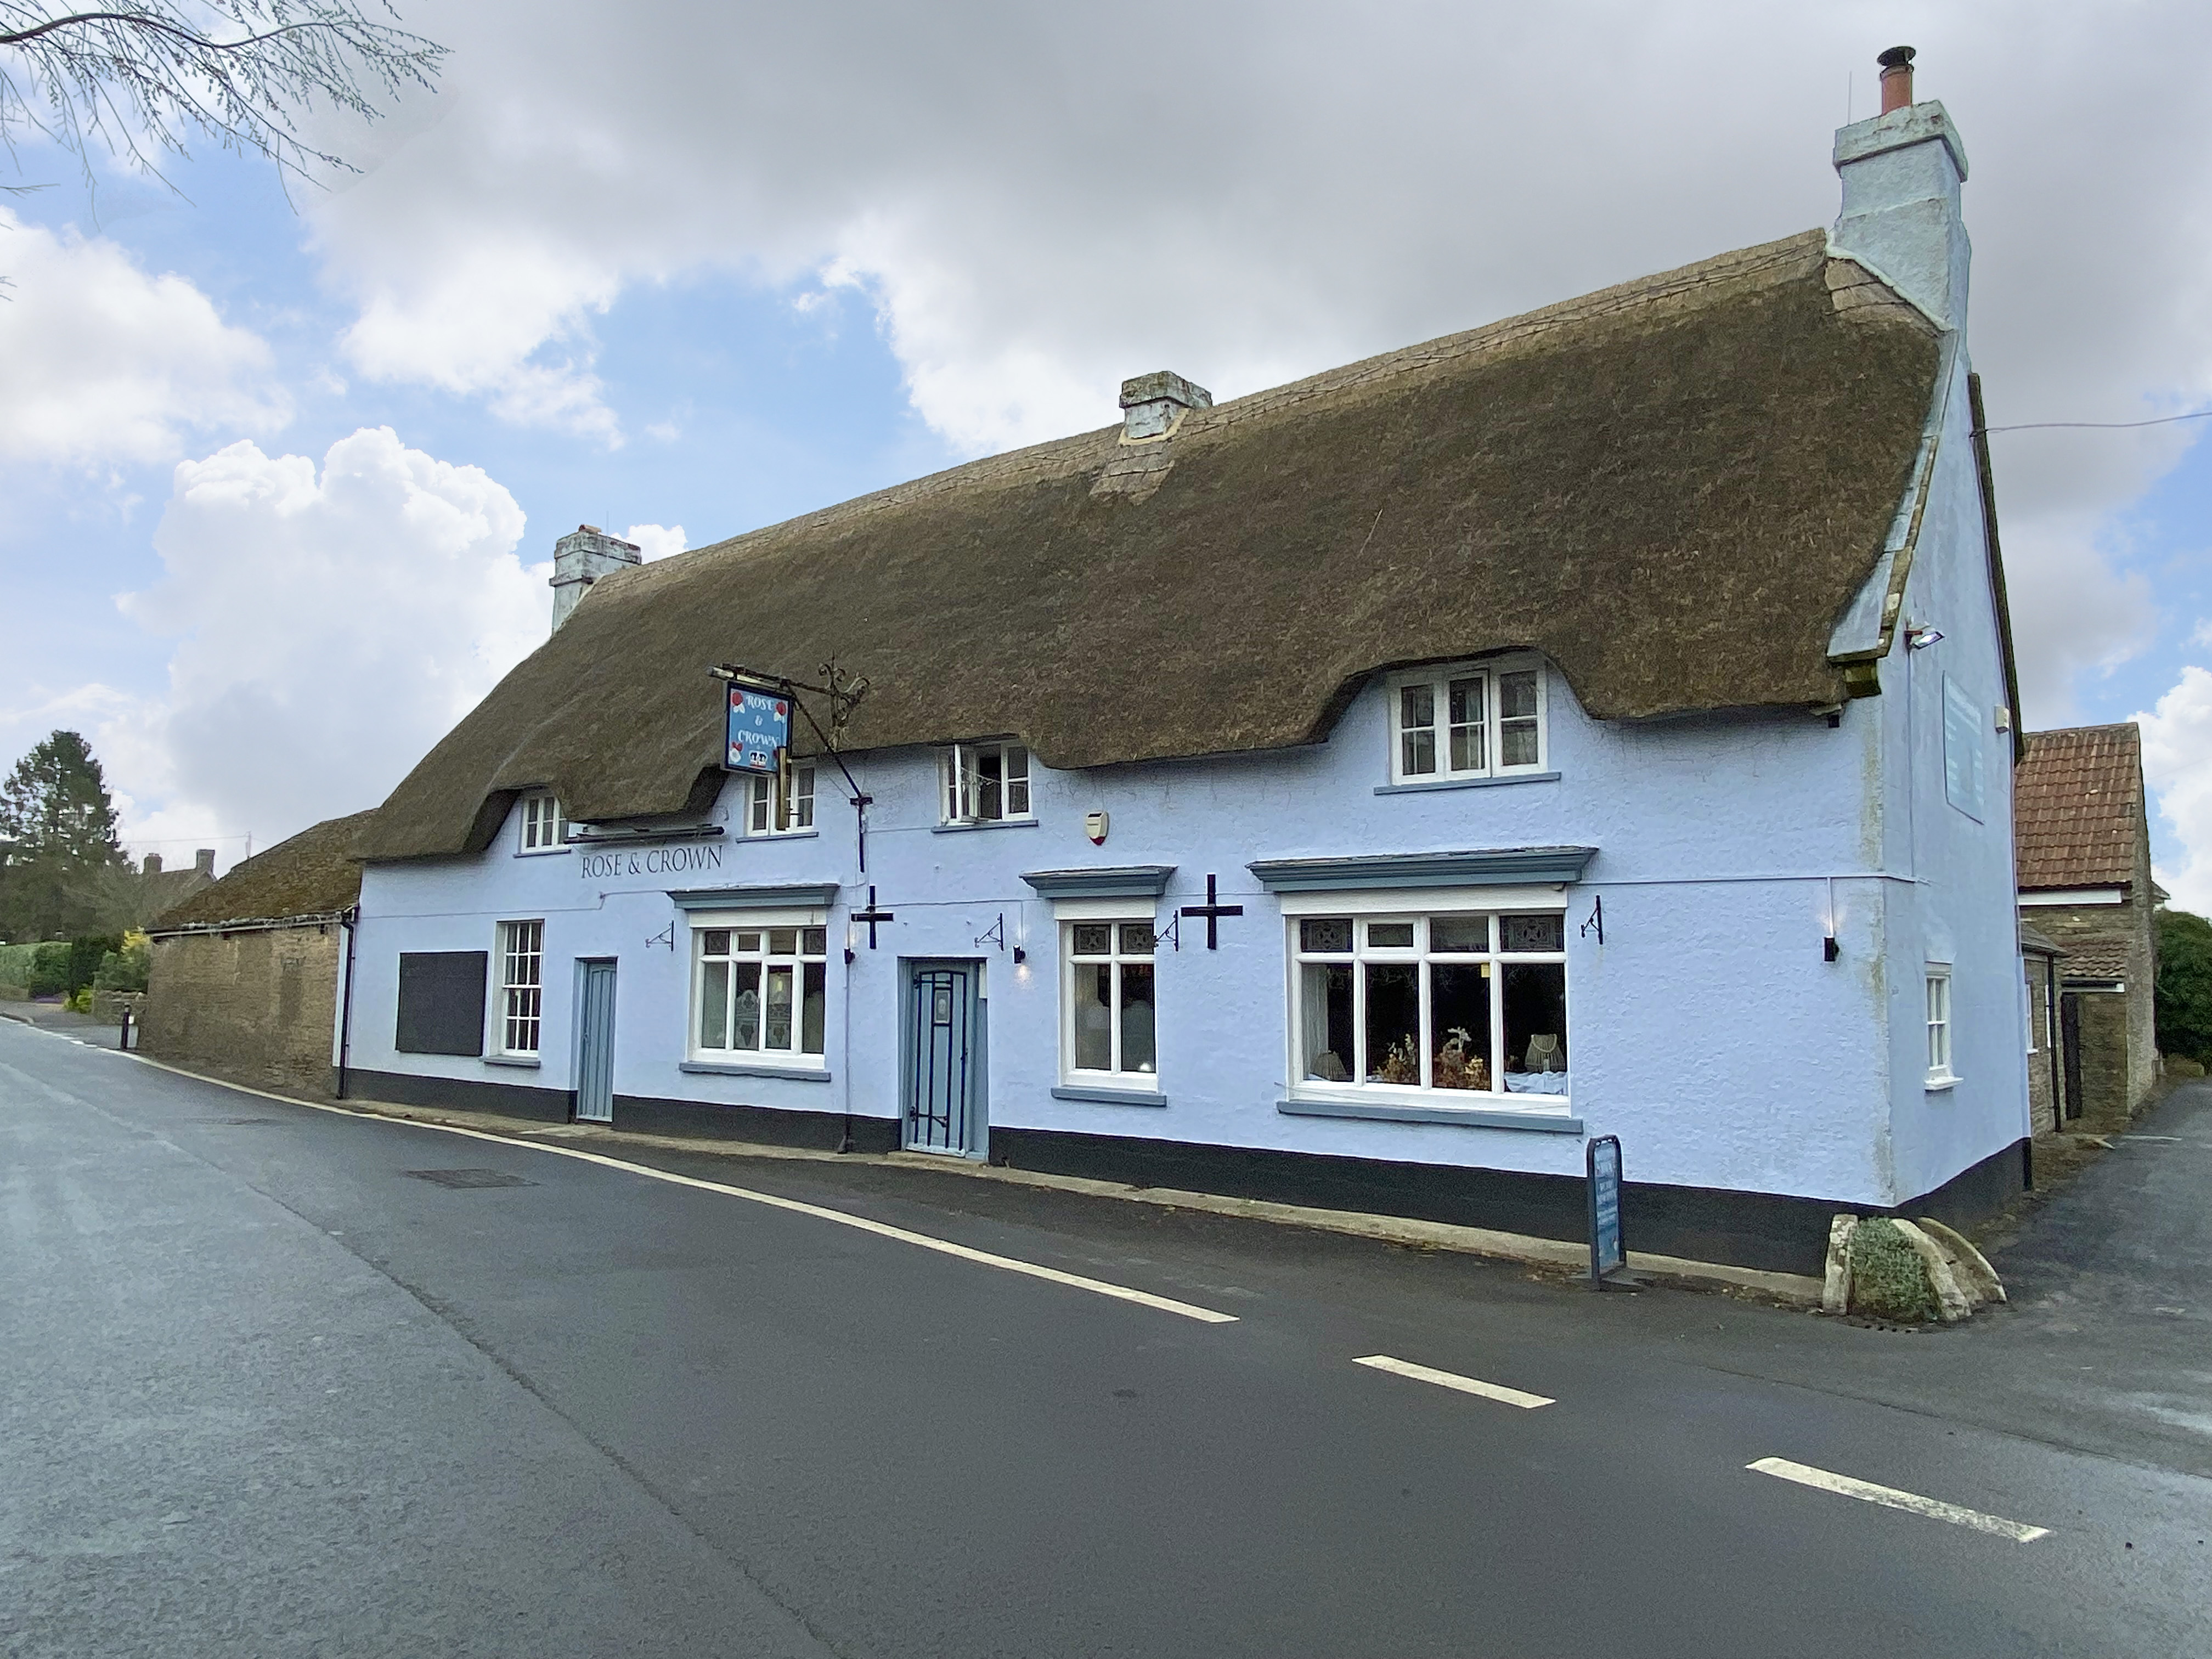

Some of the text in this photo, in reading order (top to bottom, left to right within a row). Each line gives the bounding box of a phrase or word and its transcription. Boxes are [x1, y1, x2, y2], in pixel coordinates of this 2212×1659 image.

[747, 695, 774, 710] ROSE
[755, 715, 763, 726] &
[738, 730, 780, 747] CROWN
[582, 845, 723, 878] ROSE & CROWN
